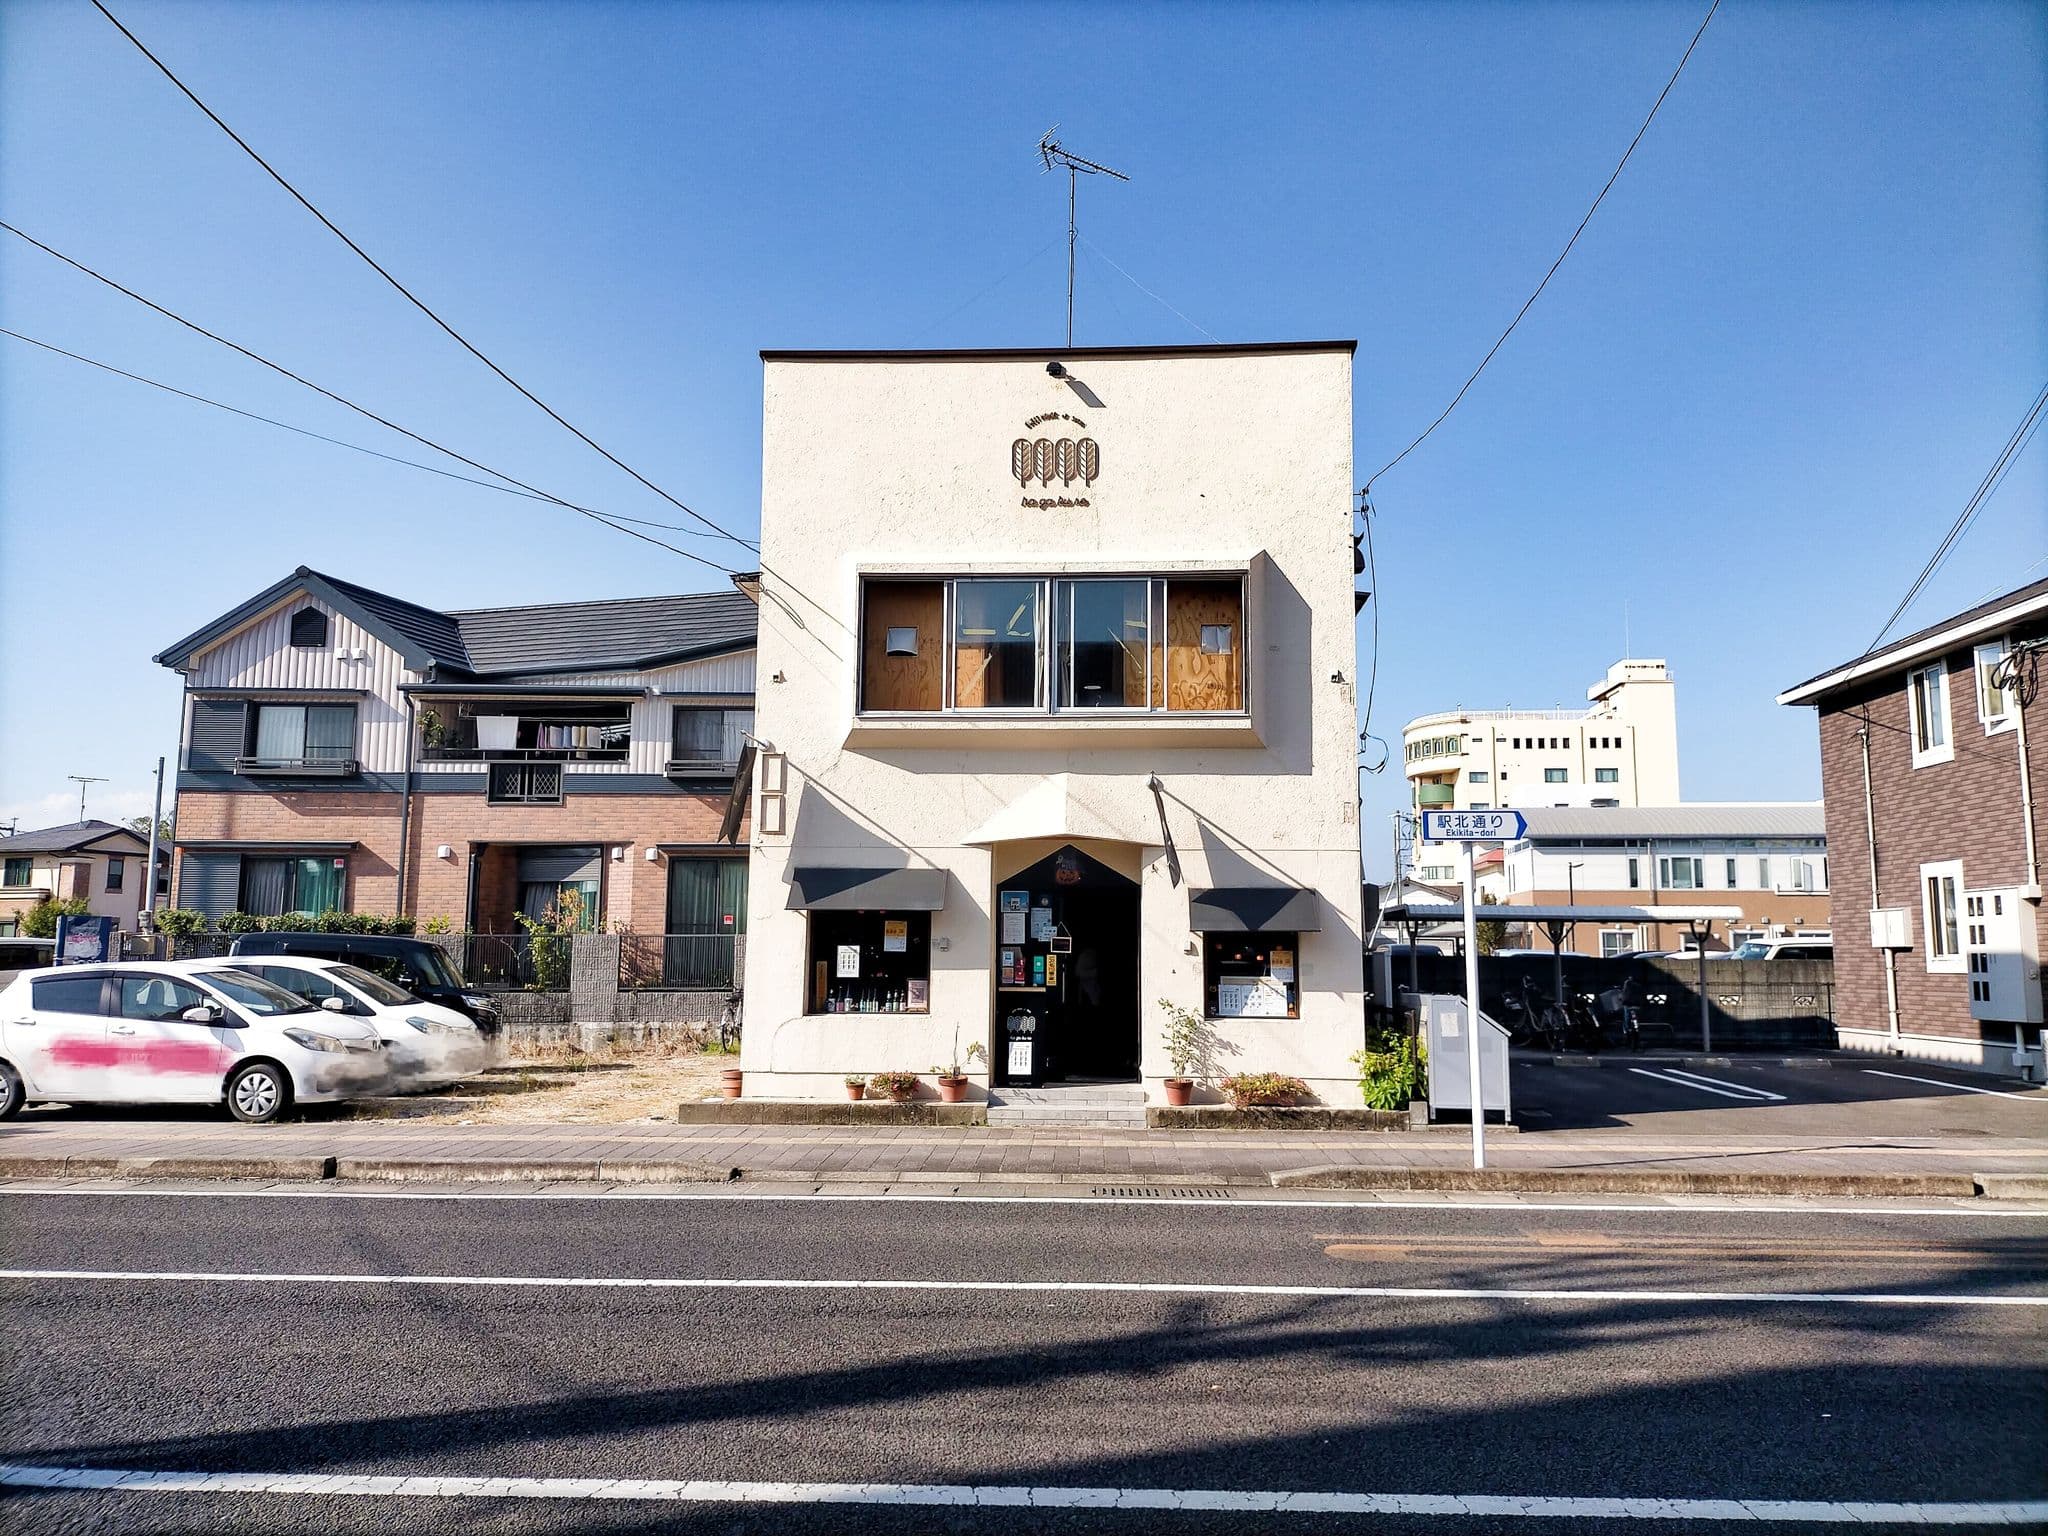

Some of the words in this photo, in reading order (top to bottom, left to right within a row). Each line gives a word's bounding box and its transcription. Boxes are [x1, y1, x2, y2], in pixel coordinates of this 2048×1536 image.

[1437, 815, 1503, 828] 駅北通り
[1446, 829, 1497, 837] Ekikita-dori
